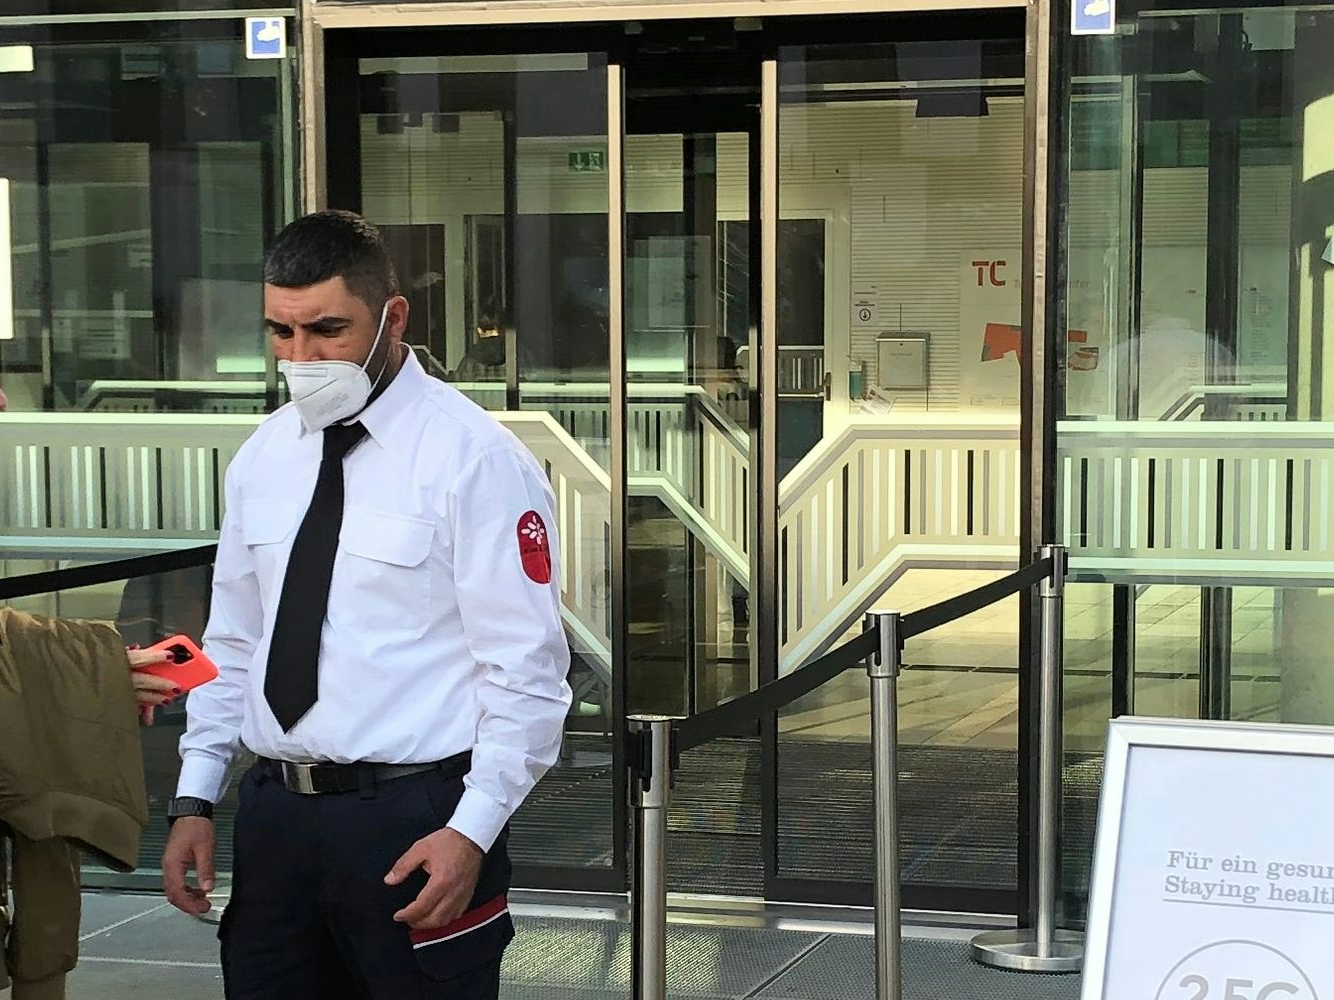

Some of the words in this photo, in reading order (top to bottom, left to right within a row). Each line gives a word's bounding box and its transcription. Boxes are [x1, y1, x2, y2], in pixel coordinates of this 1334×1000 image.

[971, 260, 1007, 287] TC
[1167, 849, 1213, 872] Für
[1220, 854, 1259, 874] ein
[1164, 874, 1260, 904] Staying
